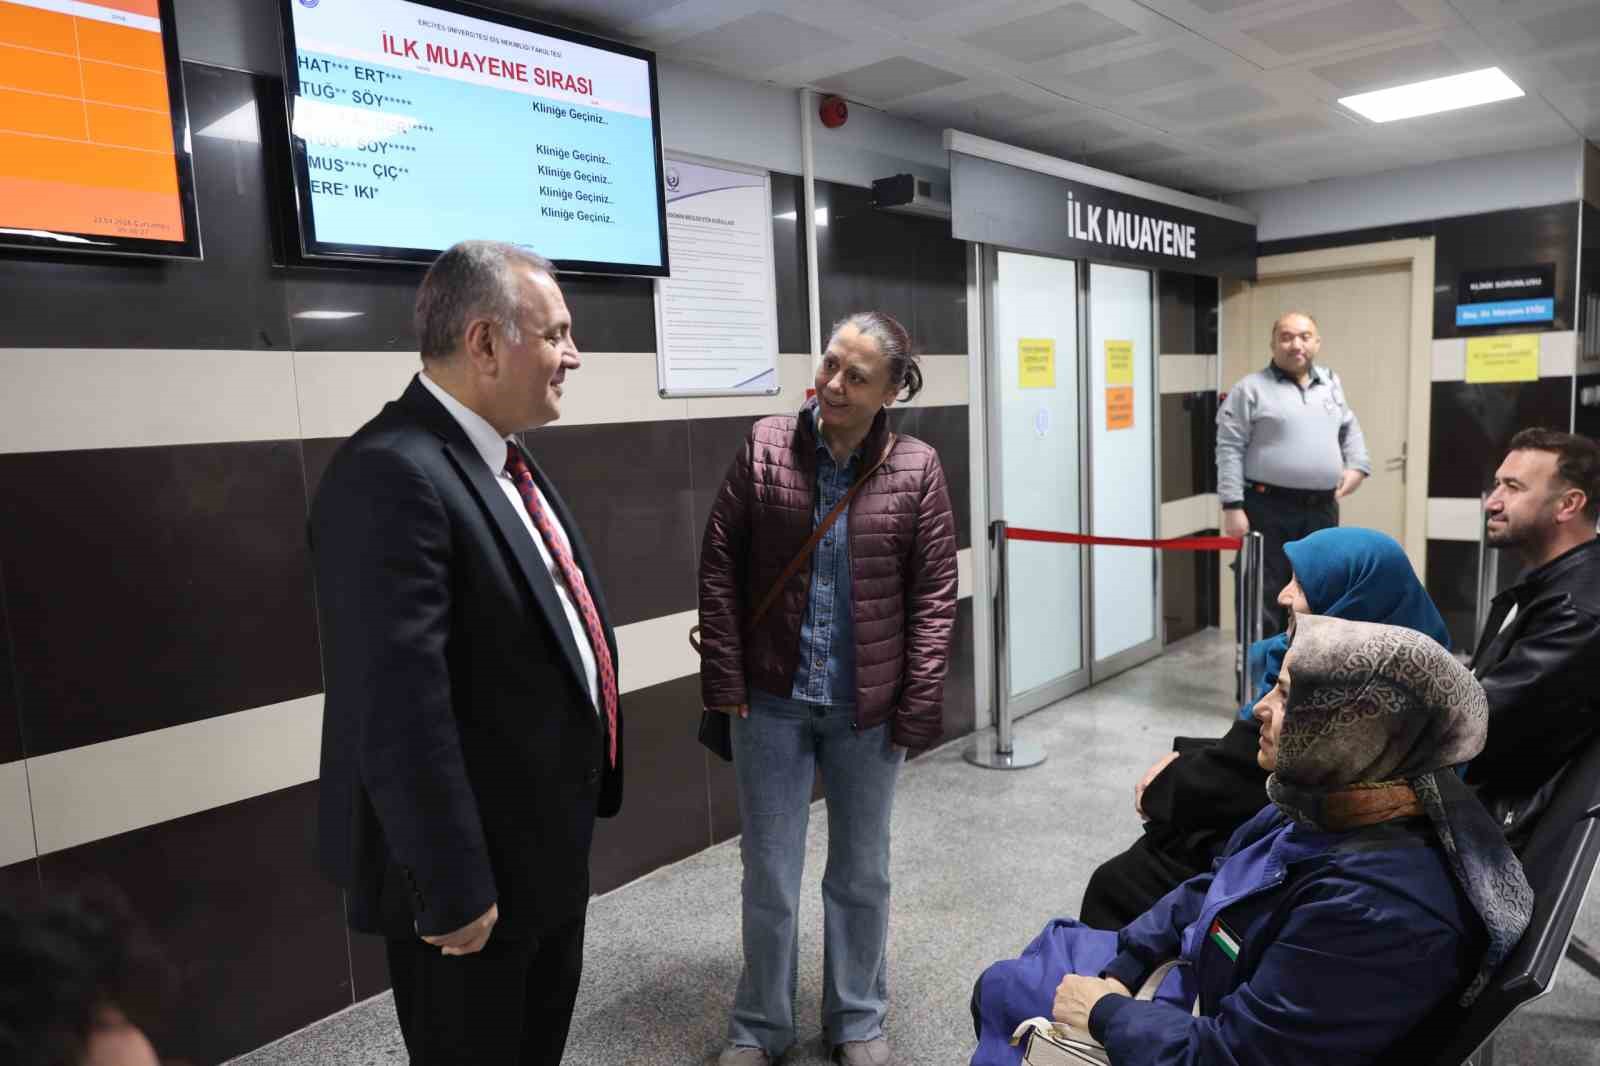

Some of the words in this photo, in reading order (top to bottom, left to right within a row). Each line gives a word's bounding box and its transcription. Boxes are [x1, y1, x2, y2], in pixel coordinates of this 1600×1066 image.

[382, 31, 420, 61] İLK
[426, 43, 529, 83] MUAYENE
[534, 67, 594, 97] SIRASI
[1067, 190, 1103, 243] İLK
[1106, 208, 1196, 259] MUAYENE
